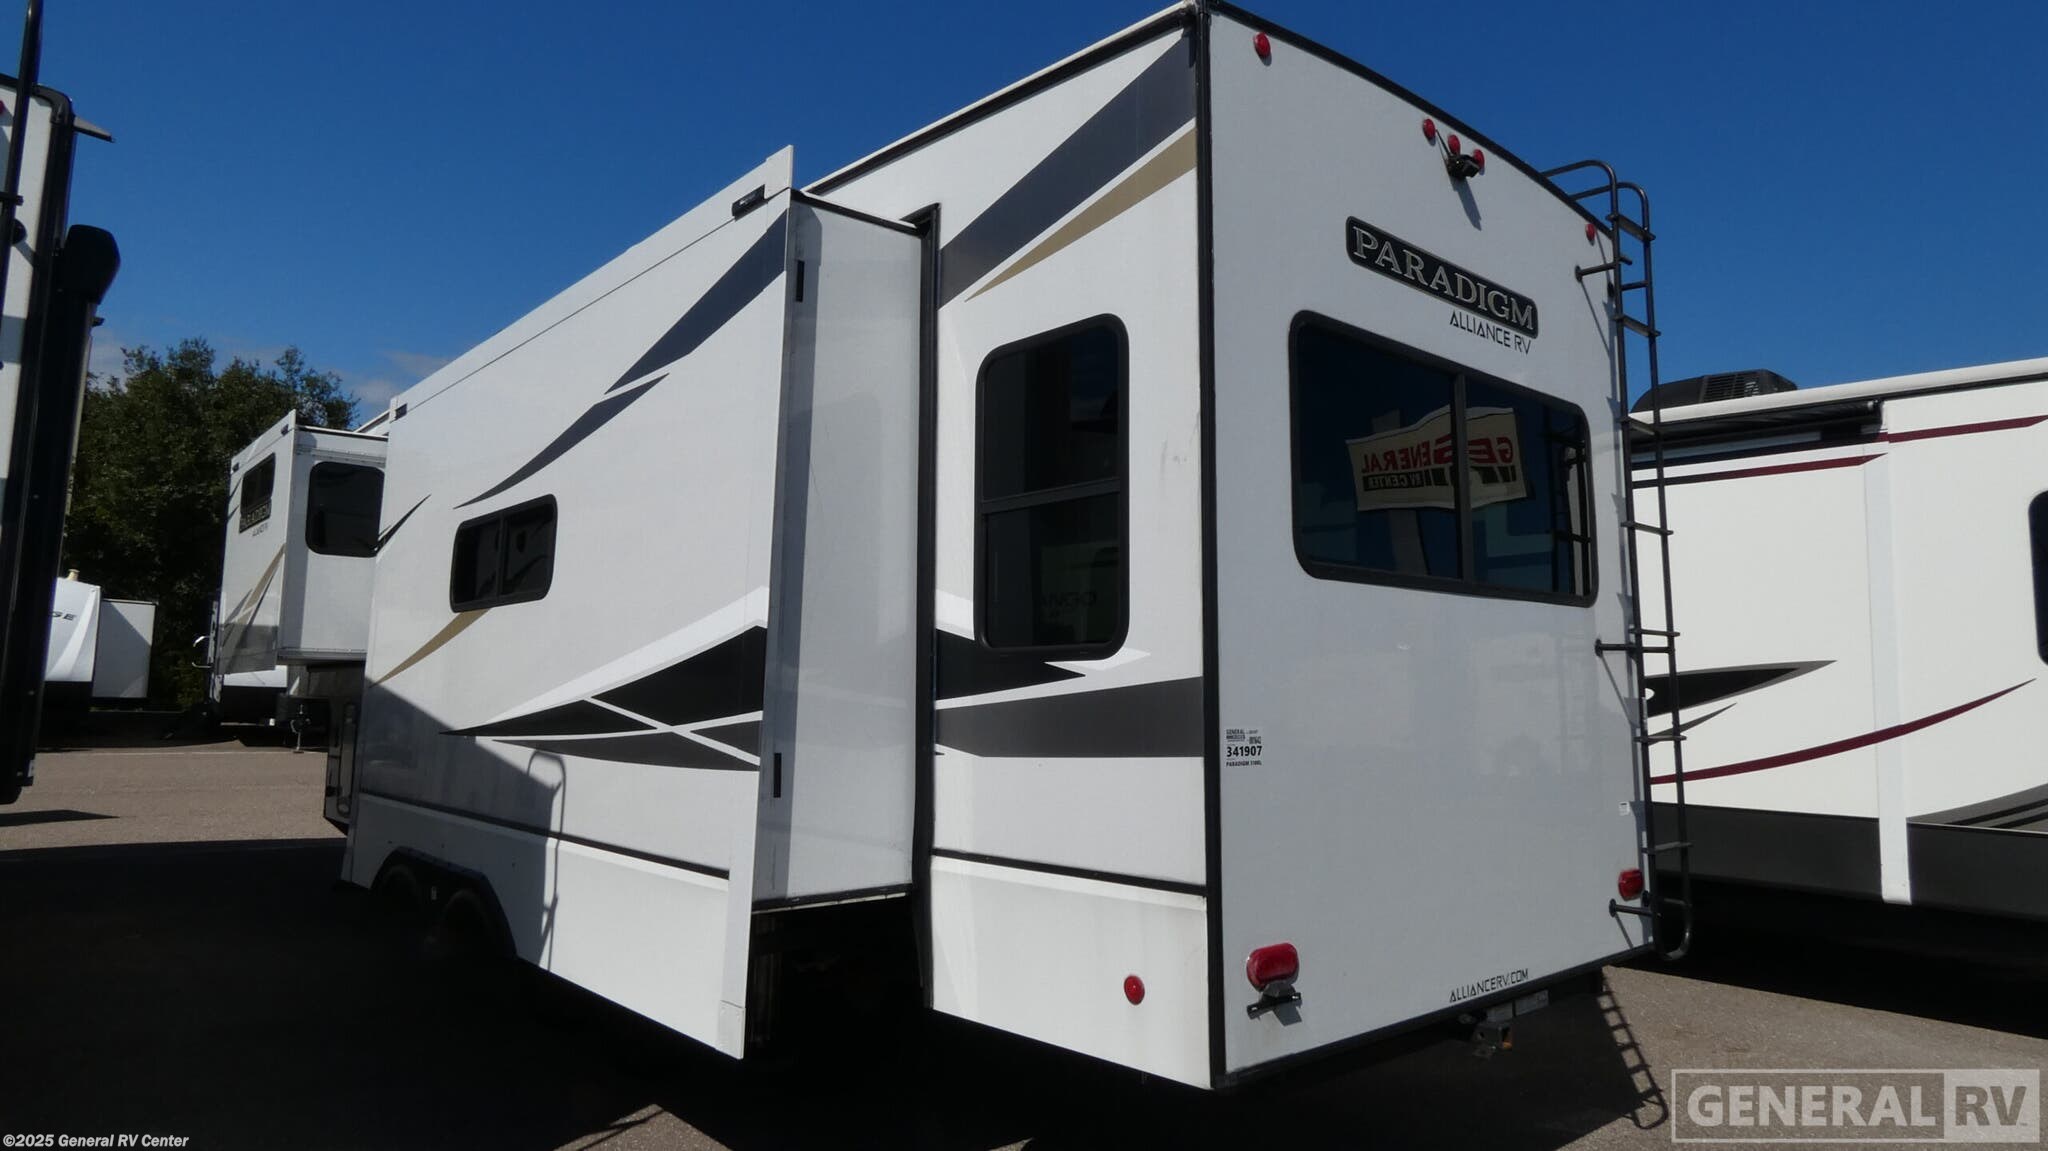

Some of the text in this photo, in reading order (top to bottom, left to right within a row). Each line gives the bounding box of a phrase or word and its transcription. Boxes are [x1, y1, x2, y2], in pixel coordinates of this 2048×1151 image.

[1353, 226, 1535, 331] PARADIGM
[1450, 310, 1532, 355] ALLIANCE RV
[1226, 745, 1262, 757] 341907
[1450, 967, 1529, 1003] ALLIANCERV.COM
